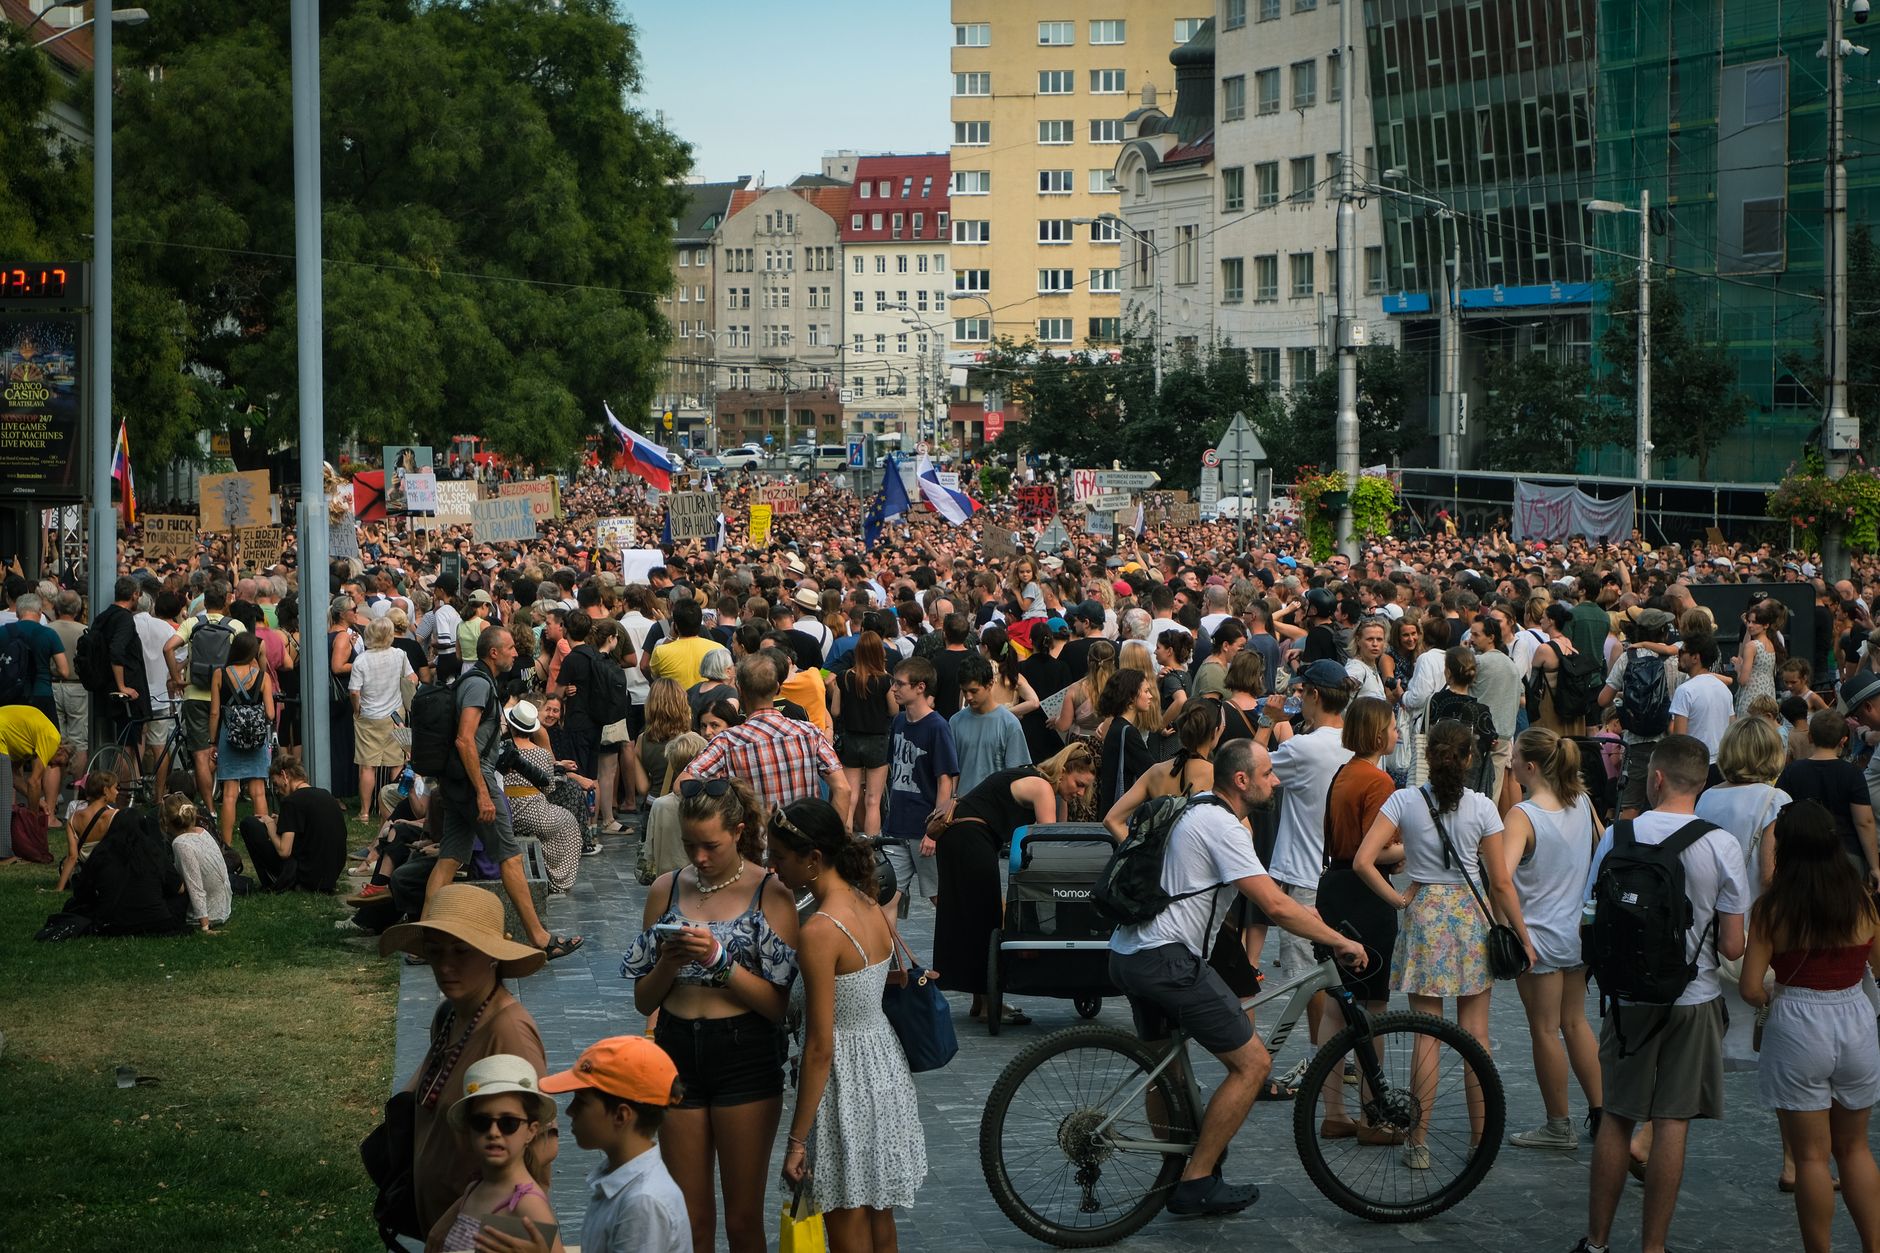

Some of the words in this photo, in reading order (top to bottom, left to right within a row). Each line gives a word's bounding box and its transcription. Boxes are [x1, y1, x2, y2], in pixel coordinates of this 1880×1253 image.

[13, 382, 42, 391] BANCO
[4, 388, 50, 400] CASINO
[39, 414, 53, 422] 24/7
[1, 422, 18, 430] LIVE
[19, 422, 47, 431] GAMES
[1, 431, 20, 439] SLOT
[21, 431, 64, 440] MACHINES
[1, 439, 18, 448] LIVE
[20, 440, 46, 449] POKER
[1520, 489, 1573, 539] VŠMU
[167, 519, 193, 532] FUCK
[145, 531, 194, 545] YOURSELF
[1052, 888, 1091, 898] hamax
